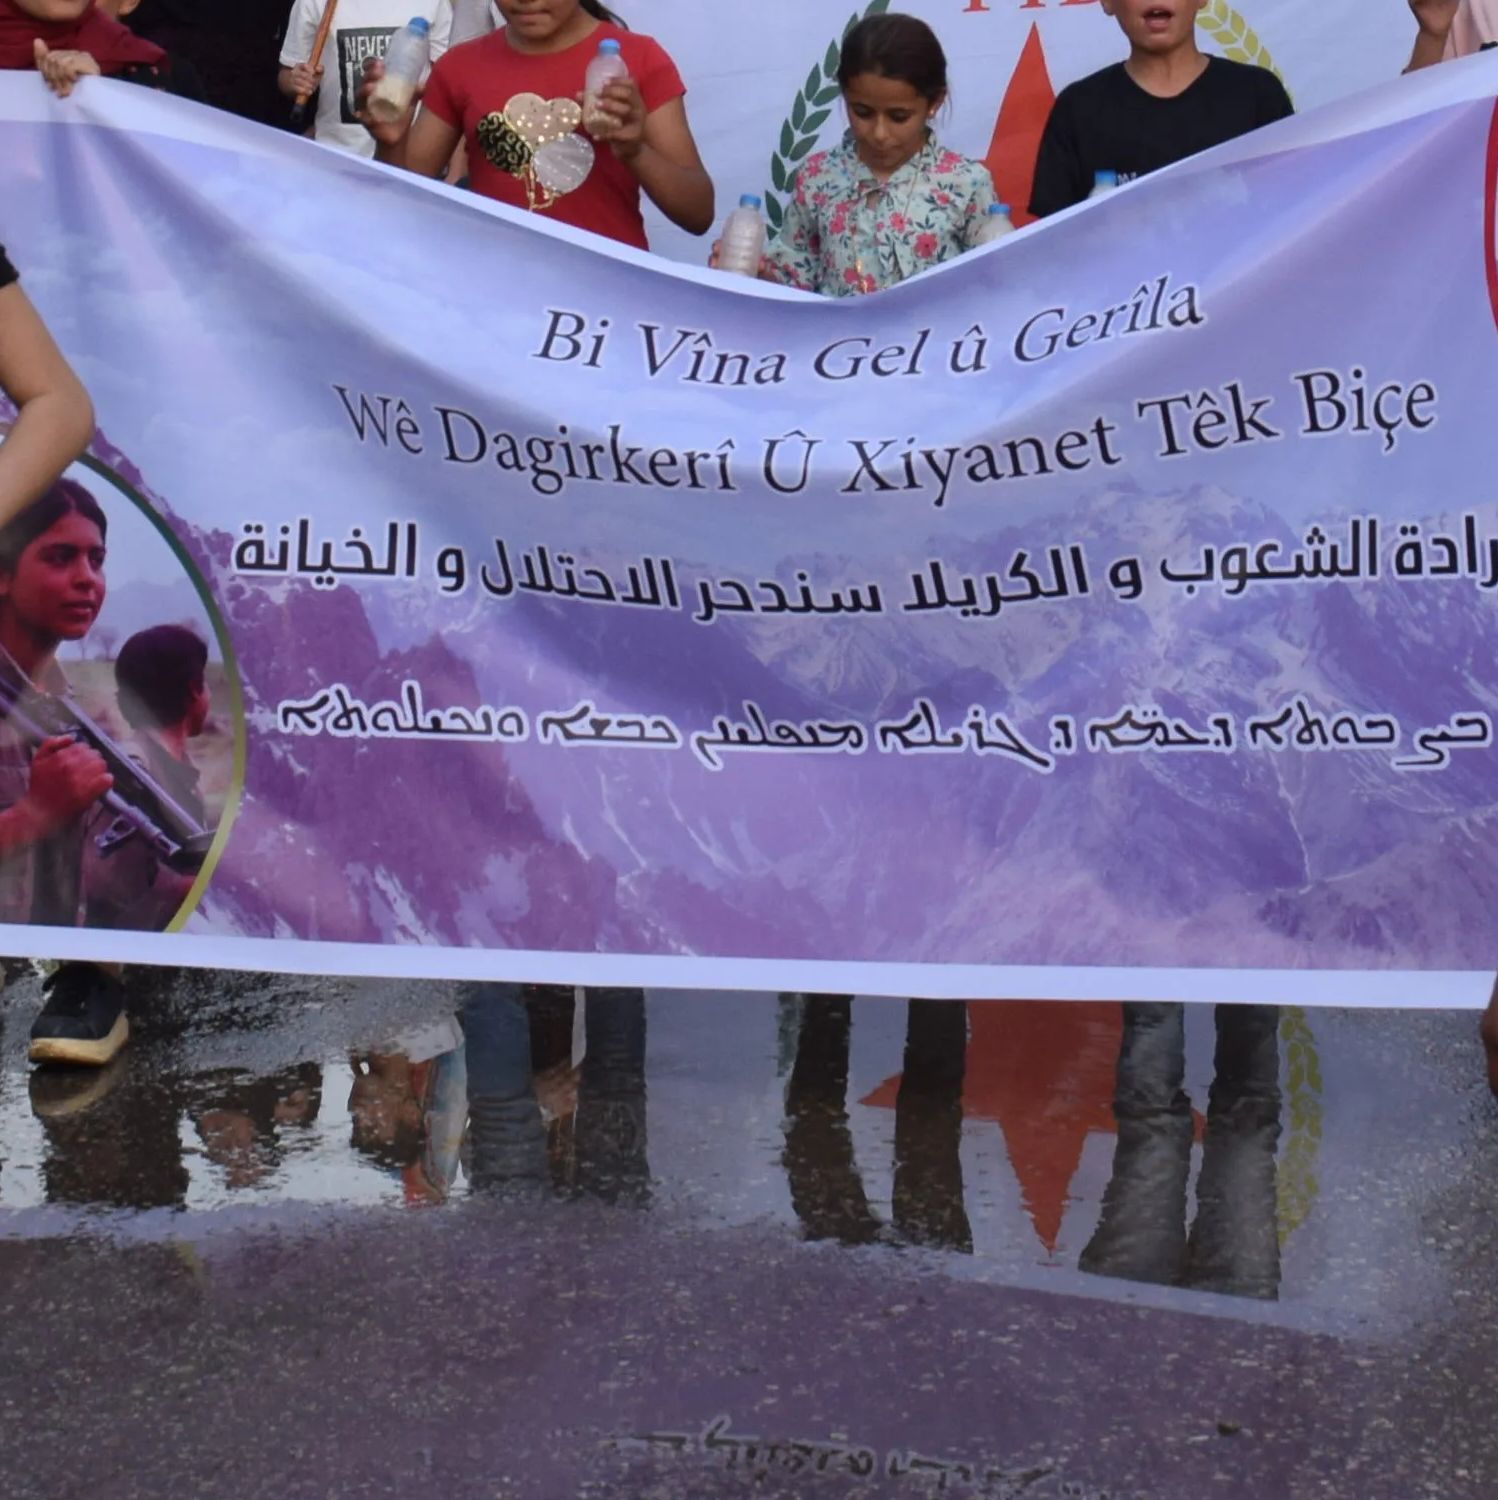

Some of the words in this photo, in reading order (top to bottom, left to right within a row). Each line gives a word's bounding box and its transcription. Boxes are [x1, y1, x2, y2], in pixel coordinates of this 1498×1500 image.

[533, 308, 610, 368] Bi
[639, 323, 787, 386] Vîna
[813, 329, 932, 382] Gel
[949, 325, 988, 374] û
[1014, 276, 1204, 365] Gerîla
[333, 385, 424, 456] Wê
[434, 406, 738, 495] Dagirkerî
[761, 429, 818, 494] Û
[840, 415, 1122, 508] Xiyanet
[1137, 383, 1280, 458] Têk
[1293, 367, 1437, 455] Biçe
[233, 518, 418, 588] الخيانة
[435, 546, 466, 593] و
[480, 538, 683, 611] الاحتلال
[901, 545, 1090, 619] الكريلا
[1108, 555, 1144, 600] و
[1159, 519, 1378, 595] الشعوب
[694, 570, 883, 625] سندحر
